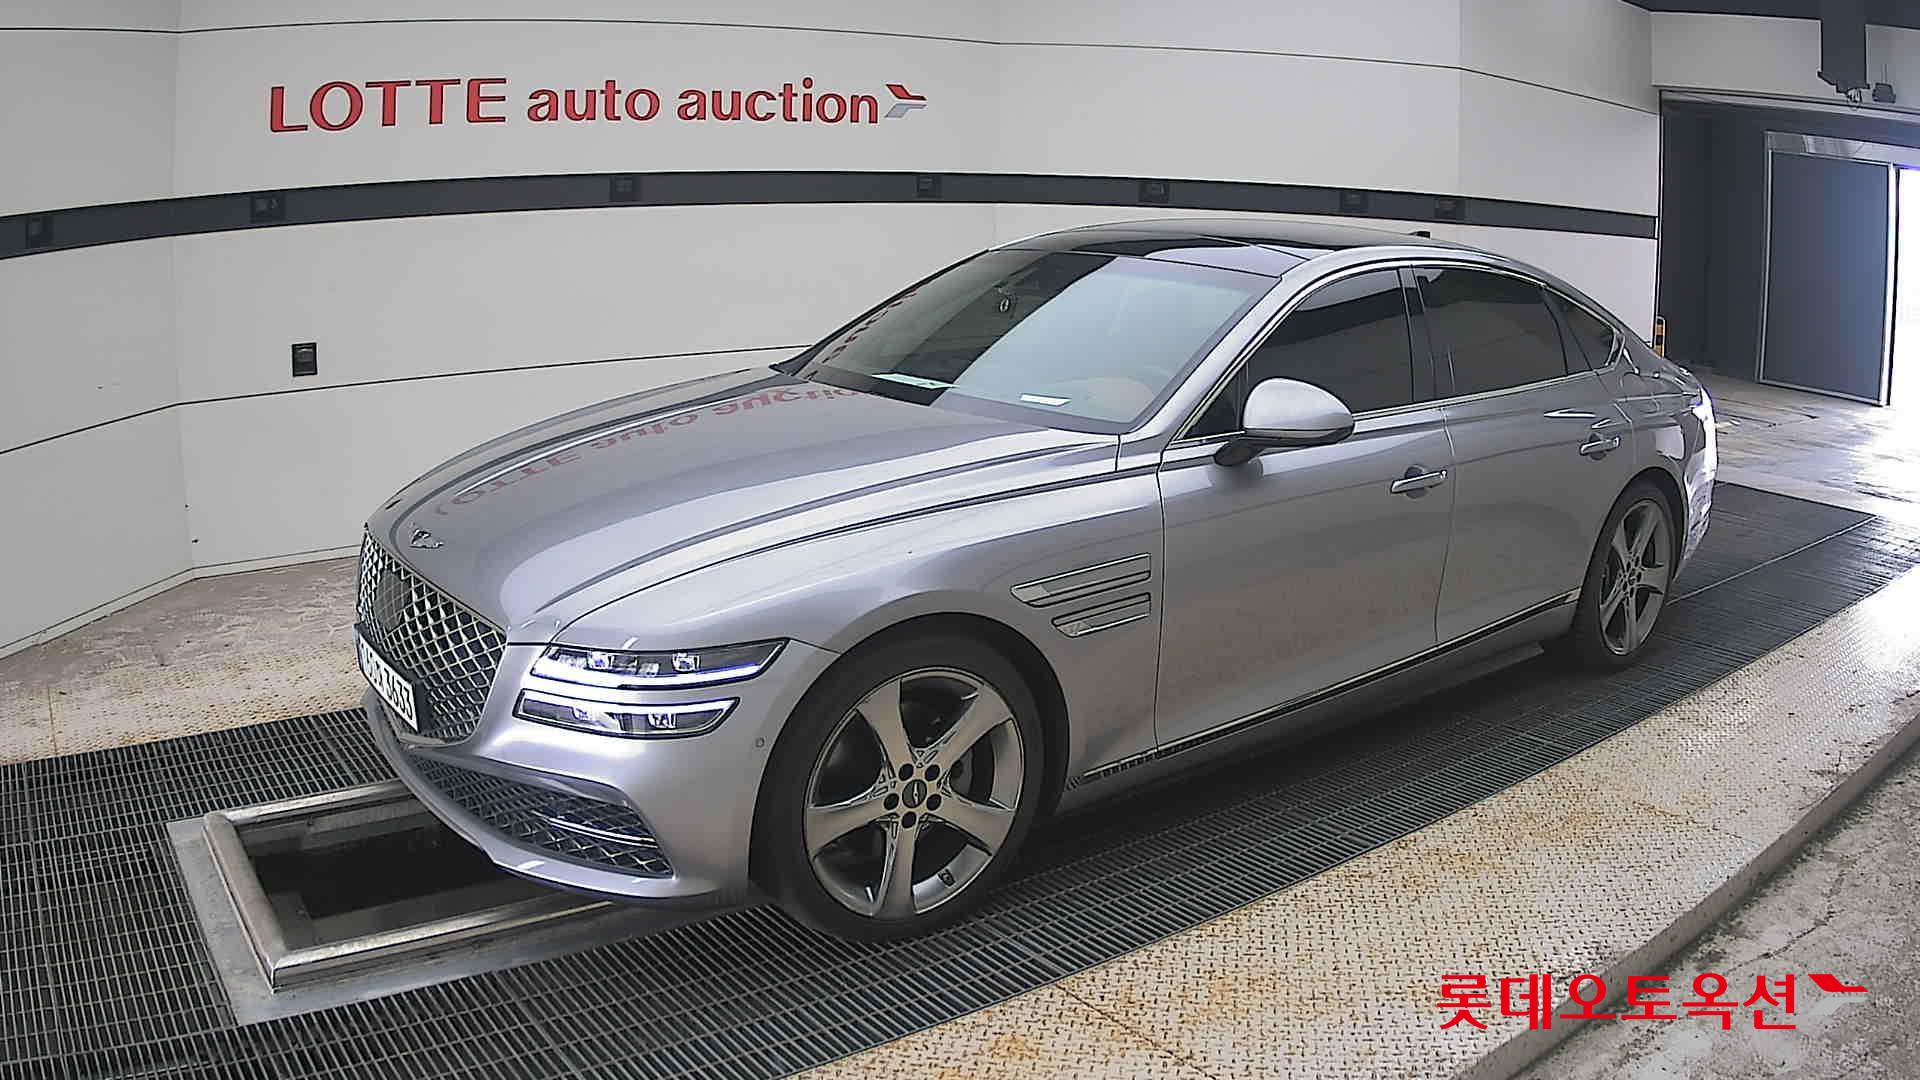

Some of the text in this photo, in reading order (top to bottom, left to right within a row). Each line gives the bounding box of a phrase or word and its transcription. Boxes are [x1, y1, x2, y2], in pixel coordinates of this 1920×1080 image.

[270, 78, 879, 132] LOTTE auto auction
